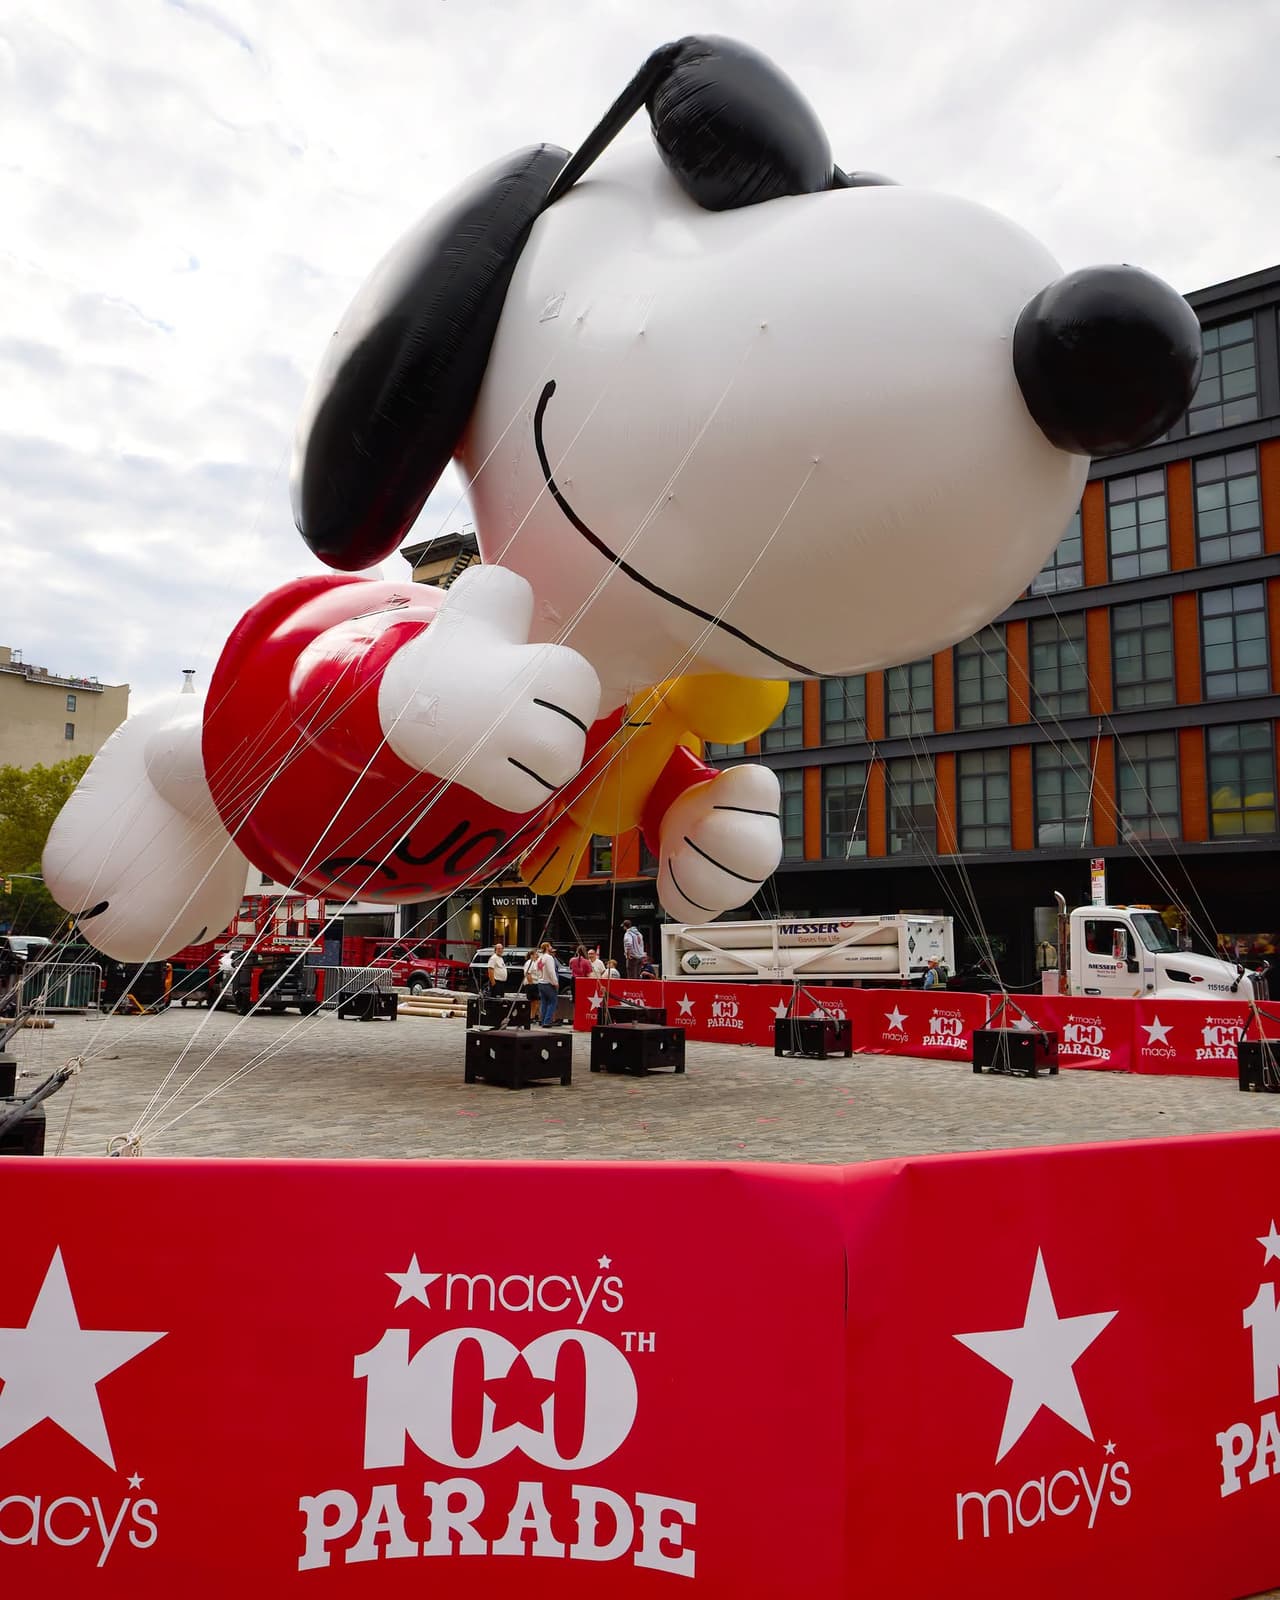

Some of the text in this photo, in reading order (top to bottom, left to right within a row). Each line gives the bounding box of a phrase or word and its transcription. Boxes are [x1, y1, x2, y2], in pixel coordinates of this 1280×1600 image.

[491, 896, 510, 906] two
[779, 923, 839, 935] MESSER
[707, 1018, 744, 1030] PARADE
[922, 1035, 968, 1051] PARADE
[1057, 1043, 1112, 1061] PARADE
[1195, 1046, 1238, 1061] PARA
[0, 1471, 158, 1568] acy's
[297, 1477, 697, 1579] PARADE
